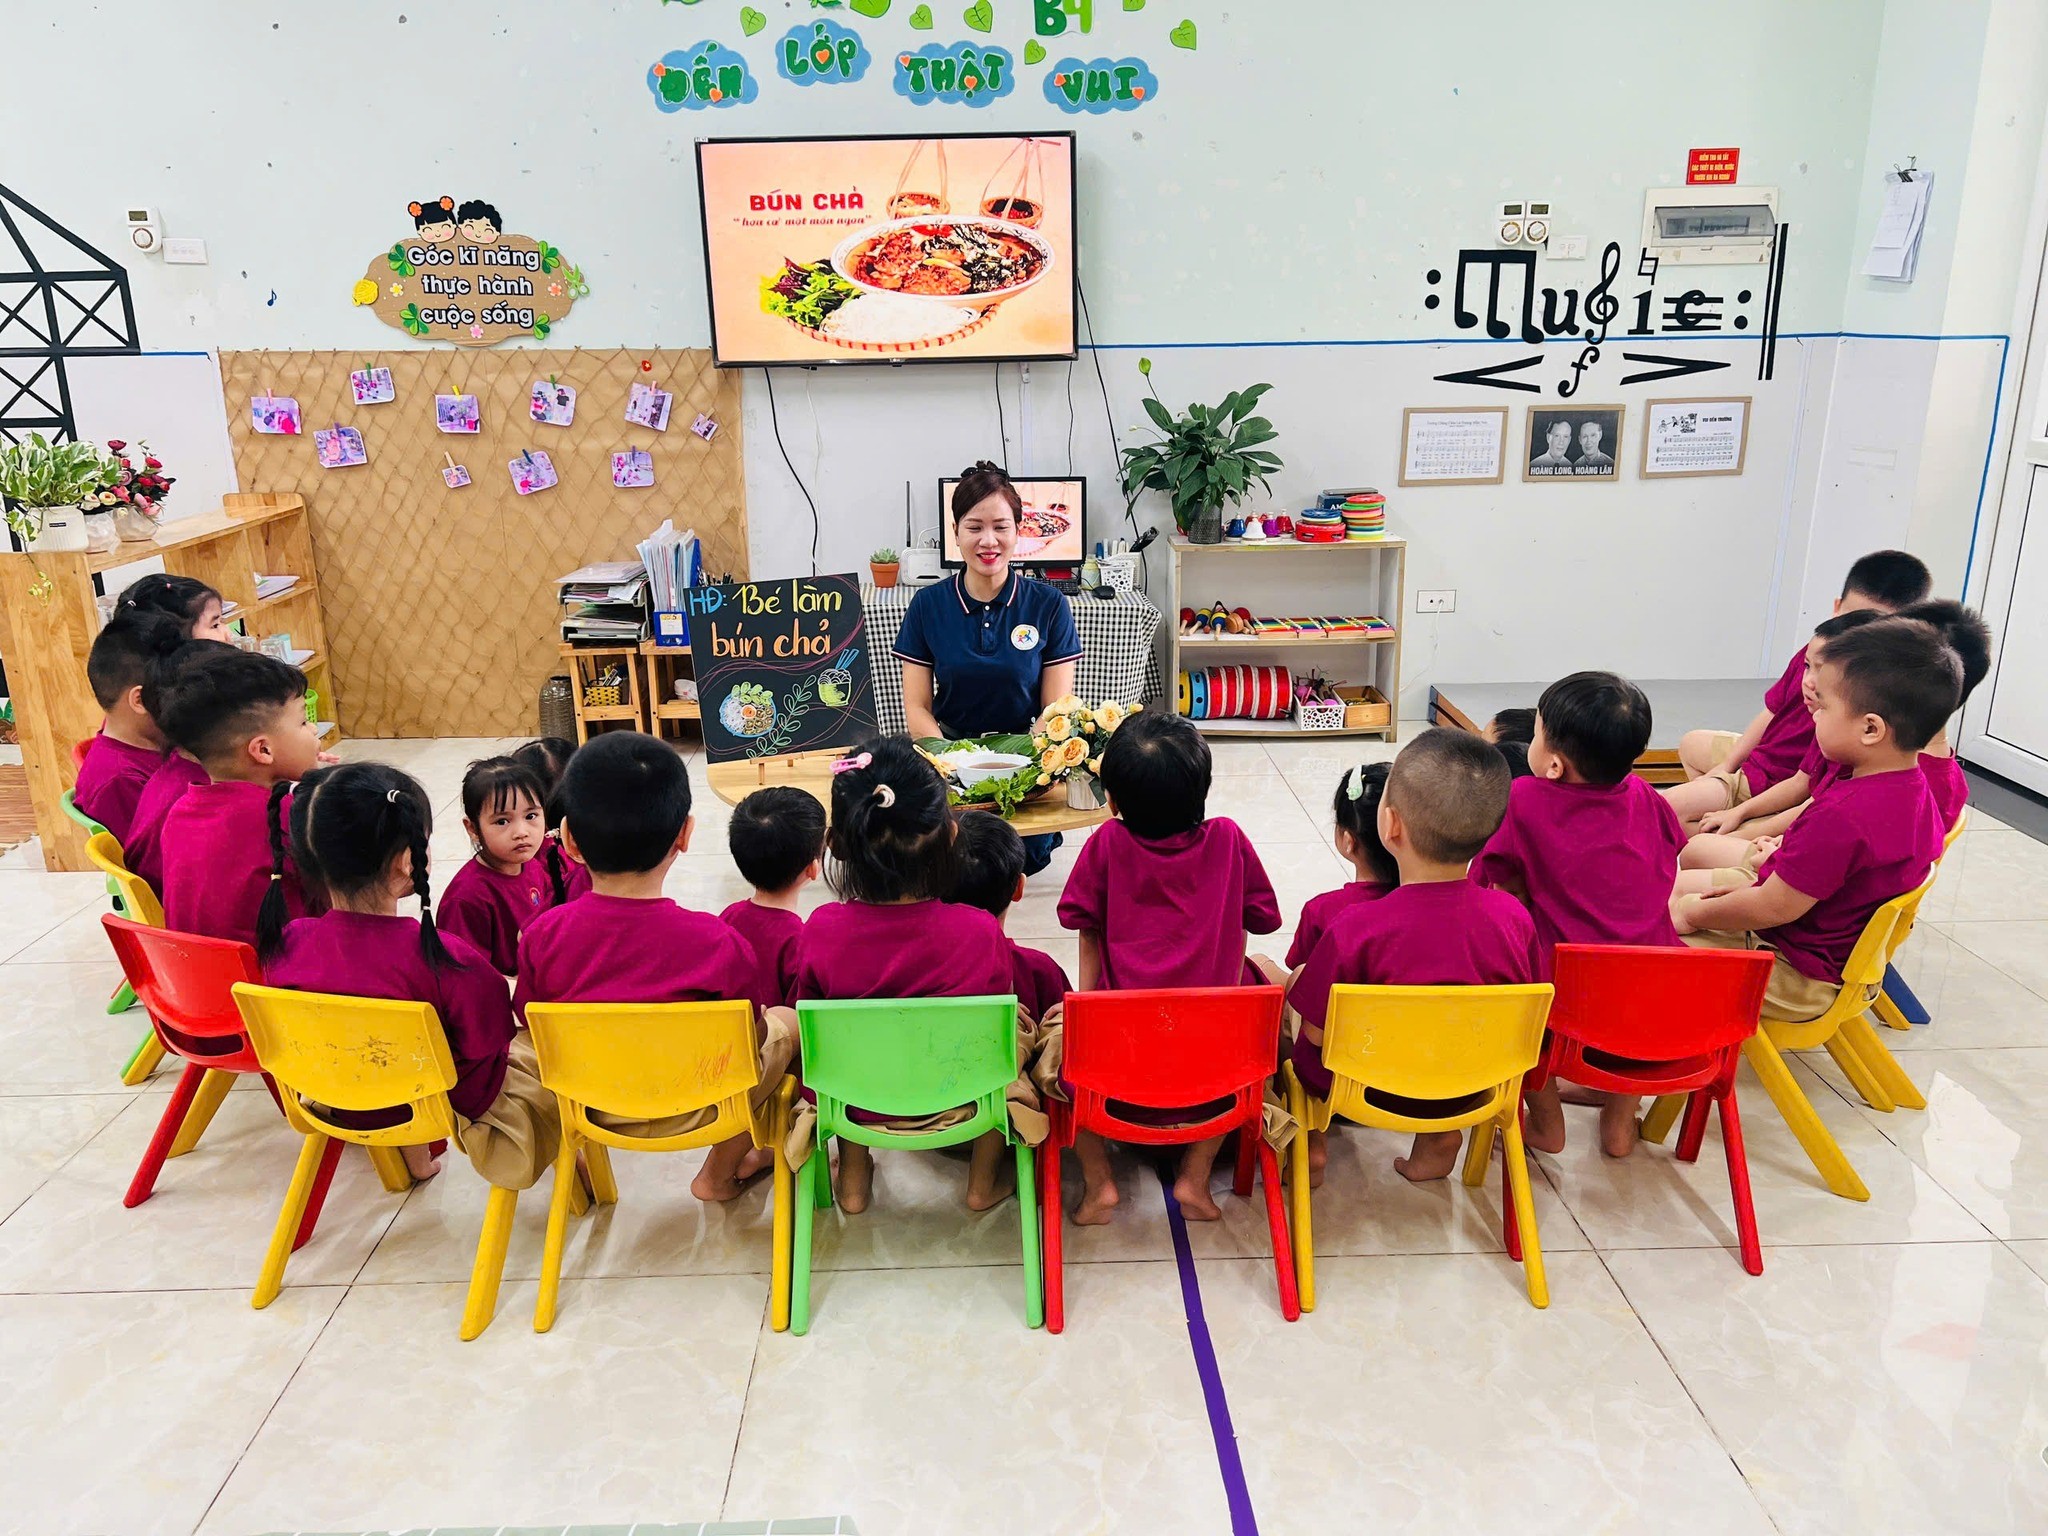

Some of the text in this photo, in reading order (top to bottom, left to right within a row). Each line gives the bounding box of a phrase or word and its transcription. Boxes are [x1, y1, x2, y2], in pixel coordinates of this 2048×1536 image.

[783, 23, 858, 78] LỚP
[903, 49, 1005, 99] THẬT
[1060, 66, 1140, 106] VUI
[749, 185, 864, 211] BÚN CHẢ
[407, 243, 454, 266] Góc
[484, 246, 541, 272] năng
[422, 273, 534, 299] thực hành
[420, 301, 534, 329] cuộc sống
[1530, 464, 1553, 475] HOÀNG
[1575, 464, 1598, 475] HOÀNG
[689, 579, 843, 616] HĐ: Bé làm
[711, 618, 831, 658] bún chả
